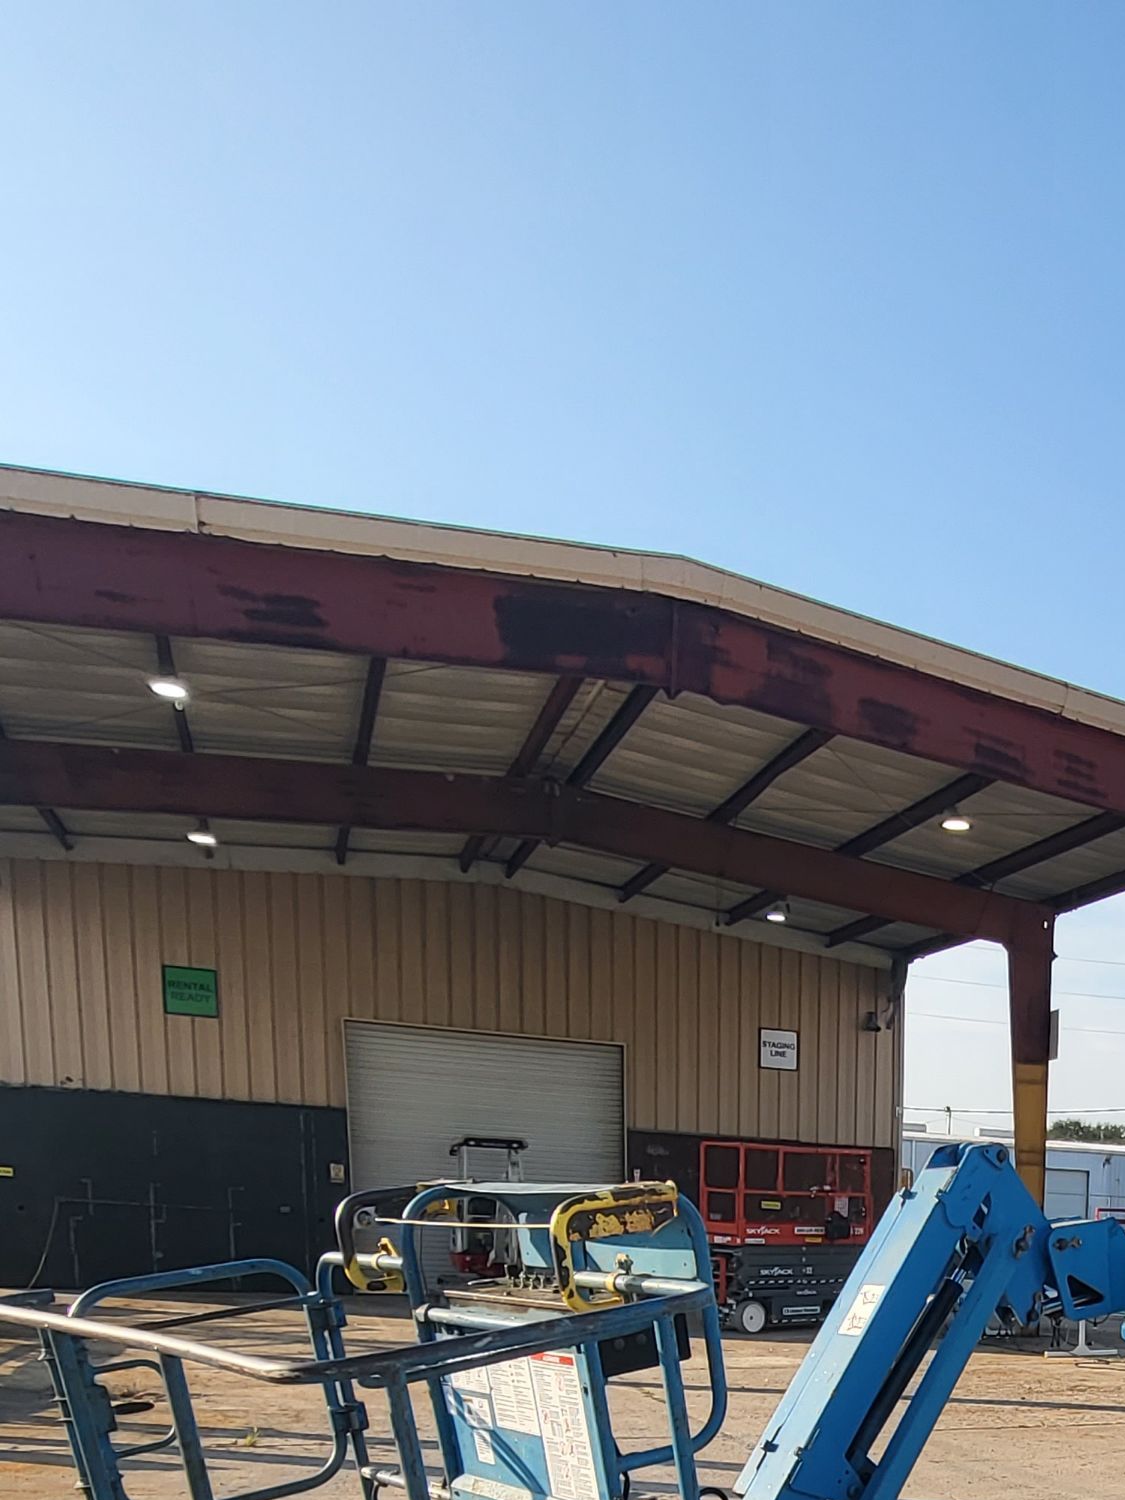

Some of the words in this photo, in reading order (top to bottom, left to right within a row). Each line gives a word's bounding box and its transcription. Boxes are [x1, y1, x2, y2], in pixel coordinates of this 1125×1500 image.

[167, 980, 213, 993] RENTAL
[170, 991, 211, 1003] READY
[762, 1040, 796, 1051] STAGING
[770, 1050, 787, 1058] LINE
[746, 1225, 781, 1235] SKYJACK
